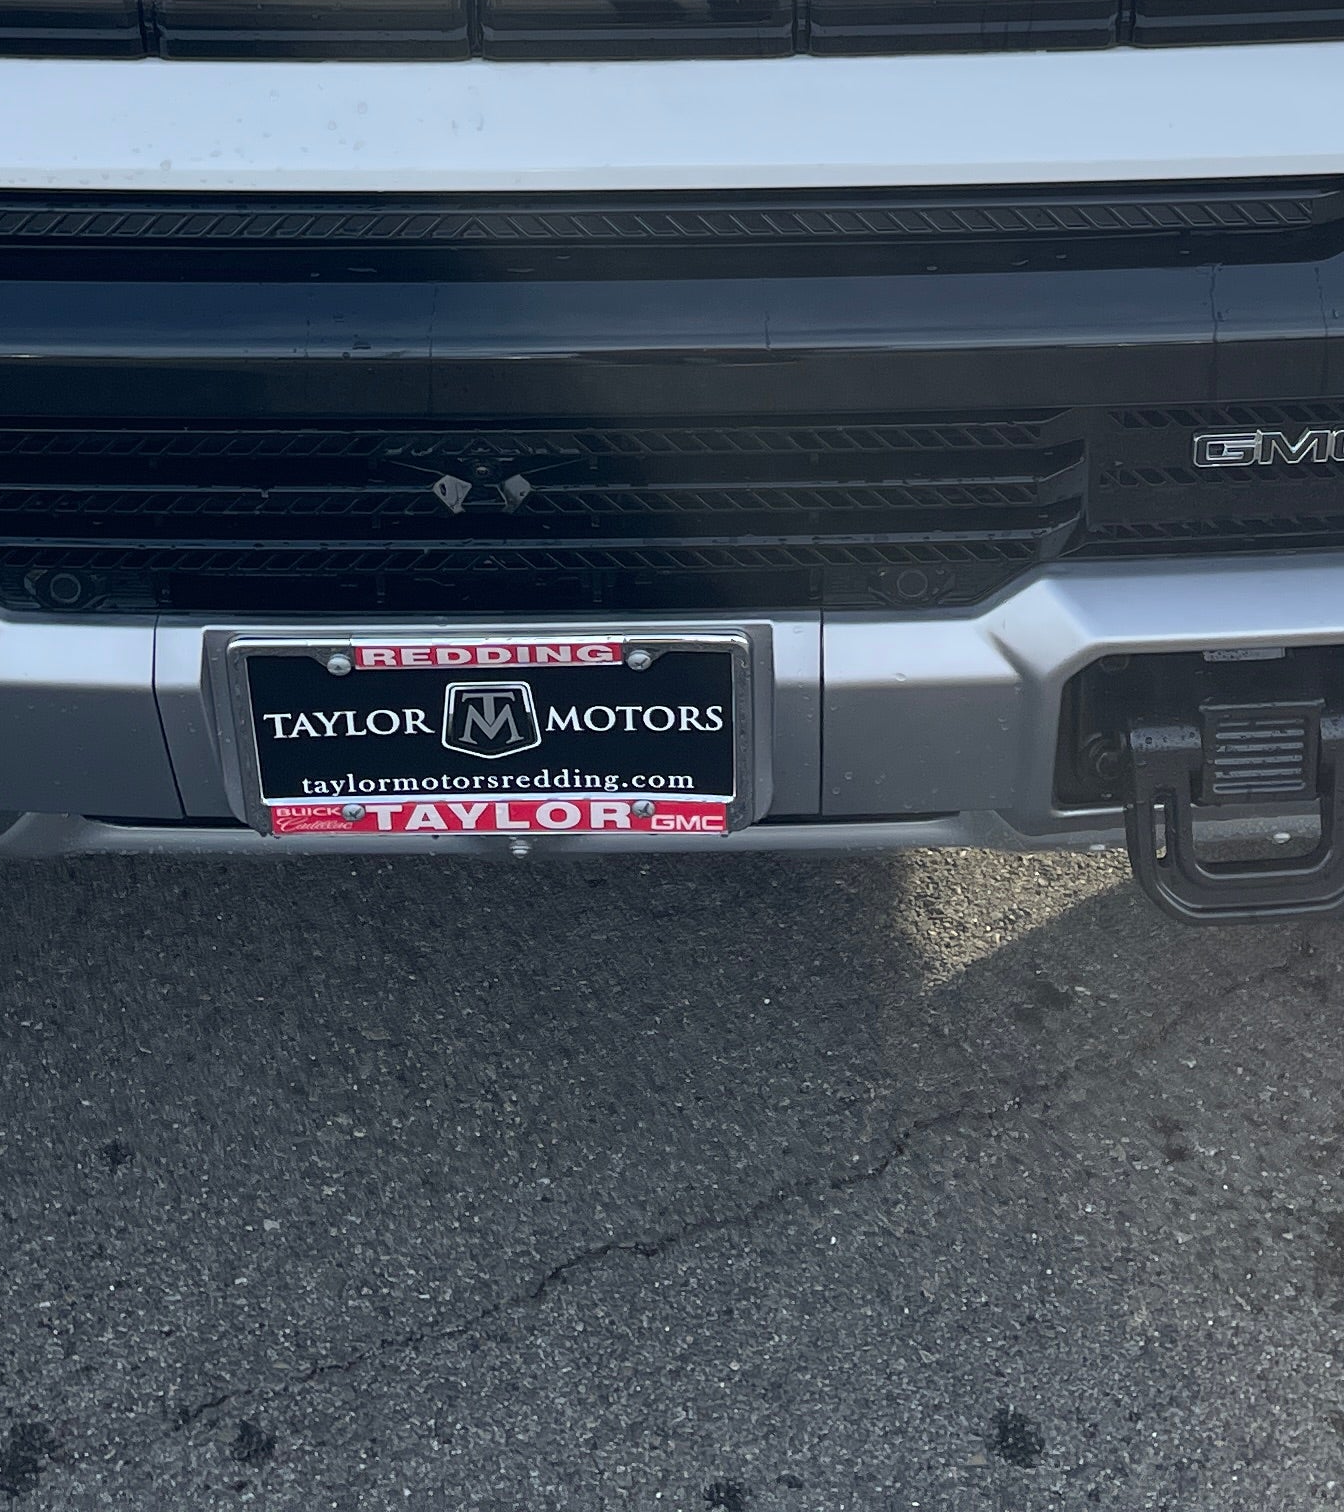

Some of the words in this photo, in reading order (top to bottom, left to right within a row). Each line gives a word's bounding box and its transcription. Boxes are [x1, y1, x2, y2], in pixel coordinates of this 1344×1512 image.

[361, 644, 613, 666] REDDING
[262, 708, 436, 739] TAYLOR
[545, 705, 724, 732] MOTORS
[301, 768, 695, 797] taylormotorsredding.com
[276, 807, 341, 817] BUICK
[365, 801, 631, 831] TAYLOR
[651, 814, 724, 830] GMC
